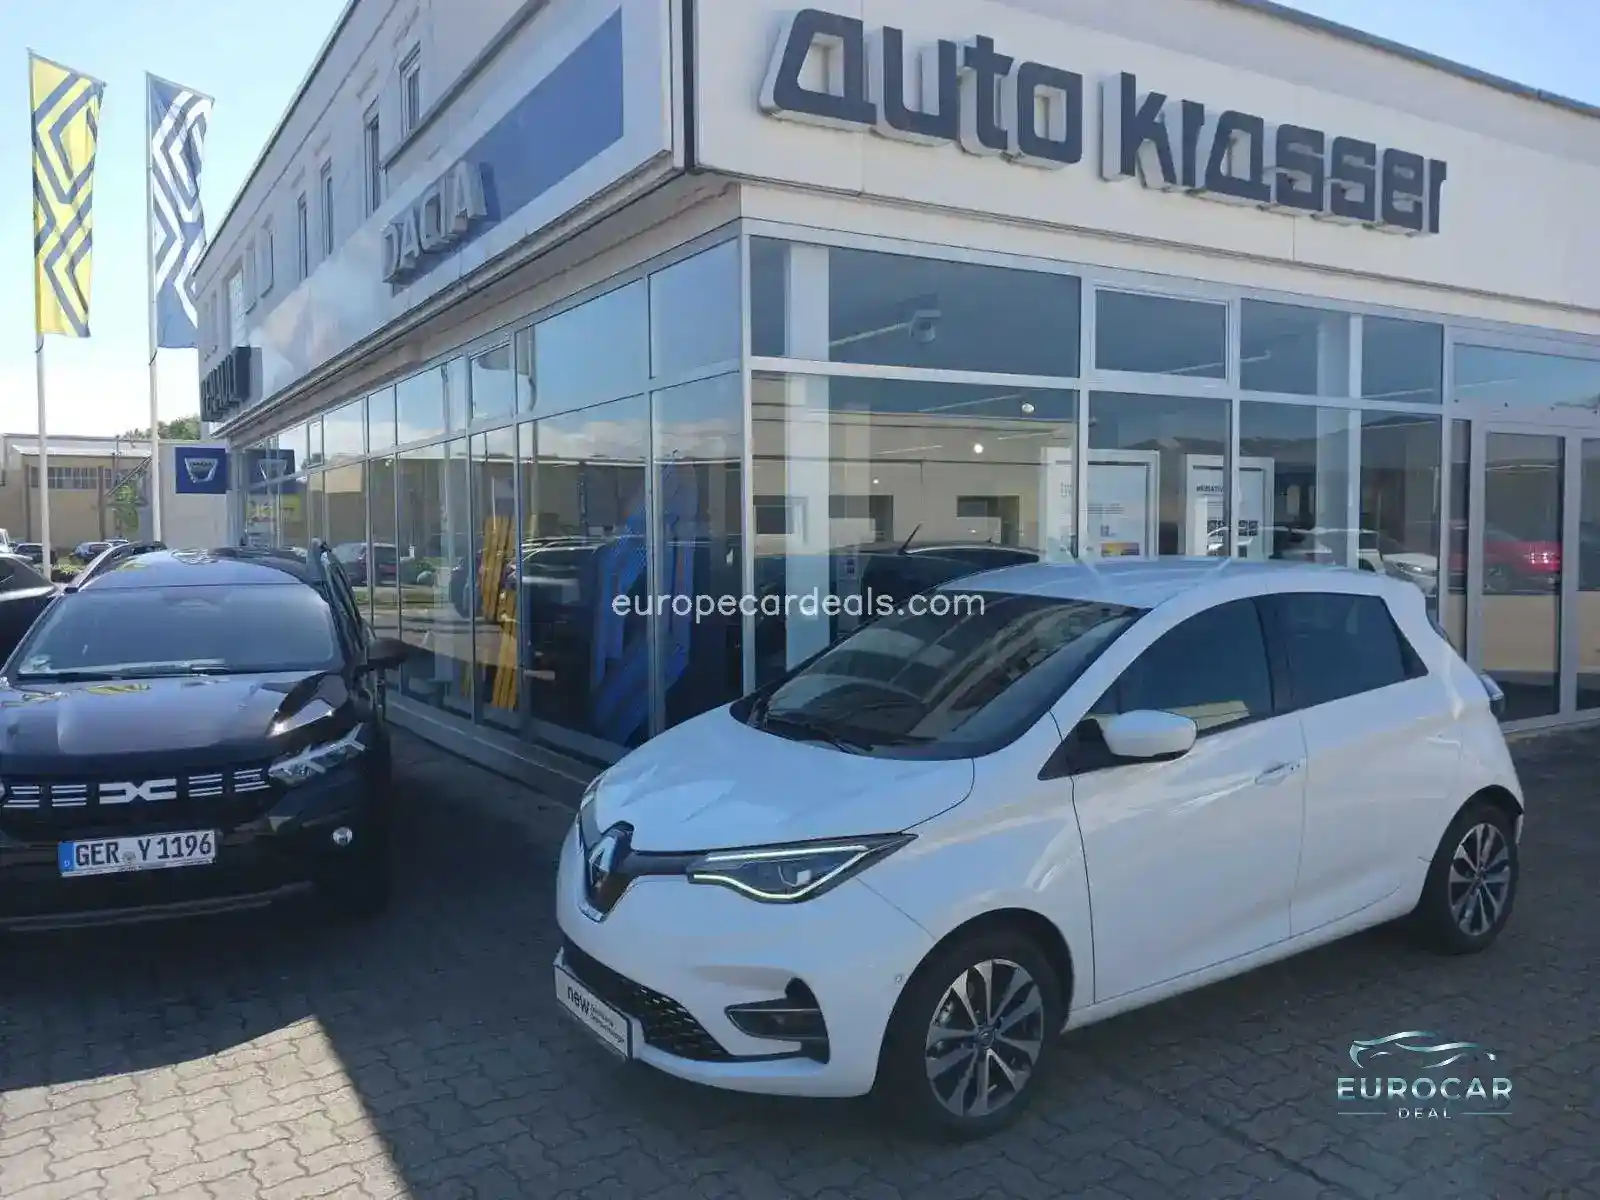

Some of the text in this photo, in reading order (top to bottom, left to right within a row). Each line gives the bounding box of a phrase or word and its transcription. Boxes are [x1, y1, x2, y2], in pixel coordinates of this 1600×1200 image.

[75, 841, 119, 866] GER
[137, 838, 151, 861] Y
[157, 833, 212, 860] 1196
